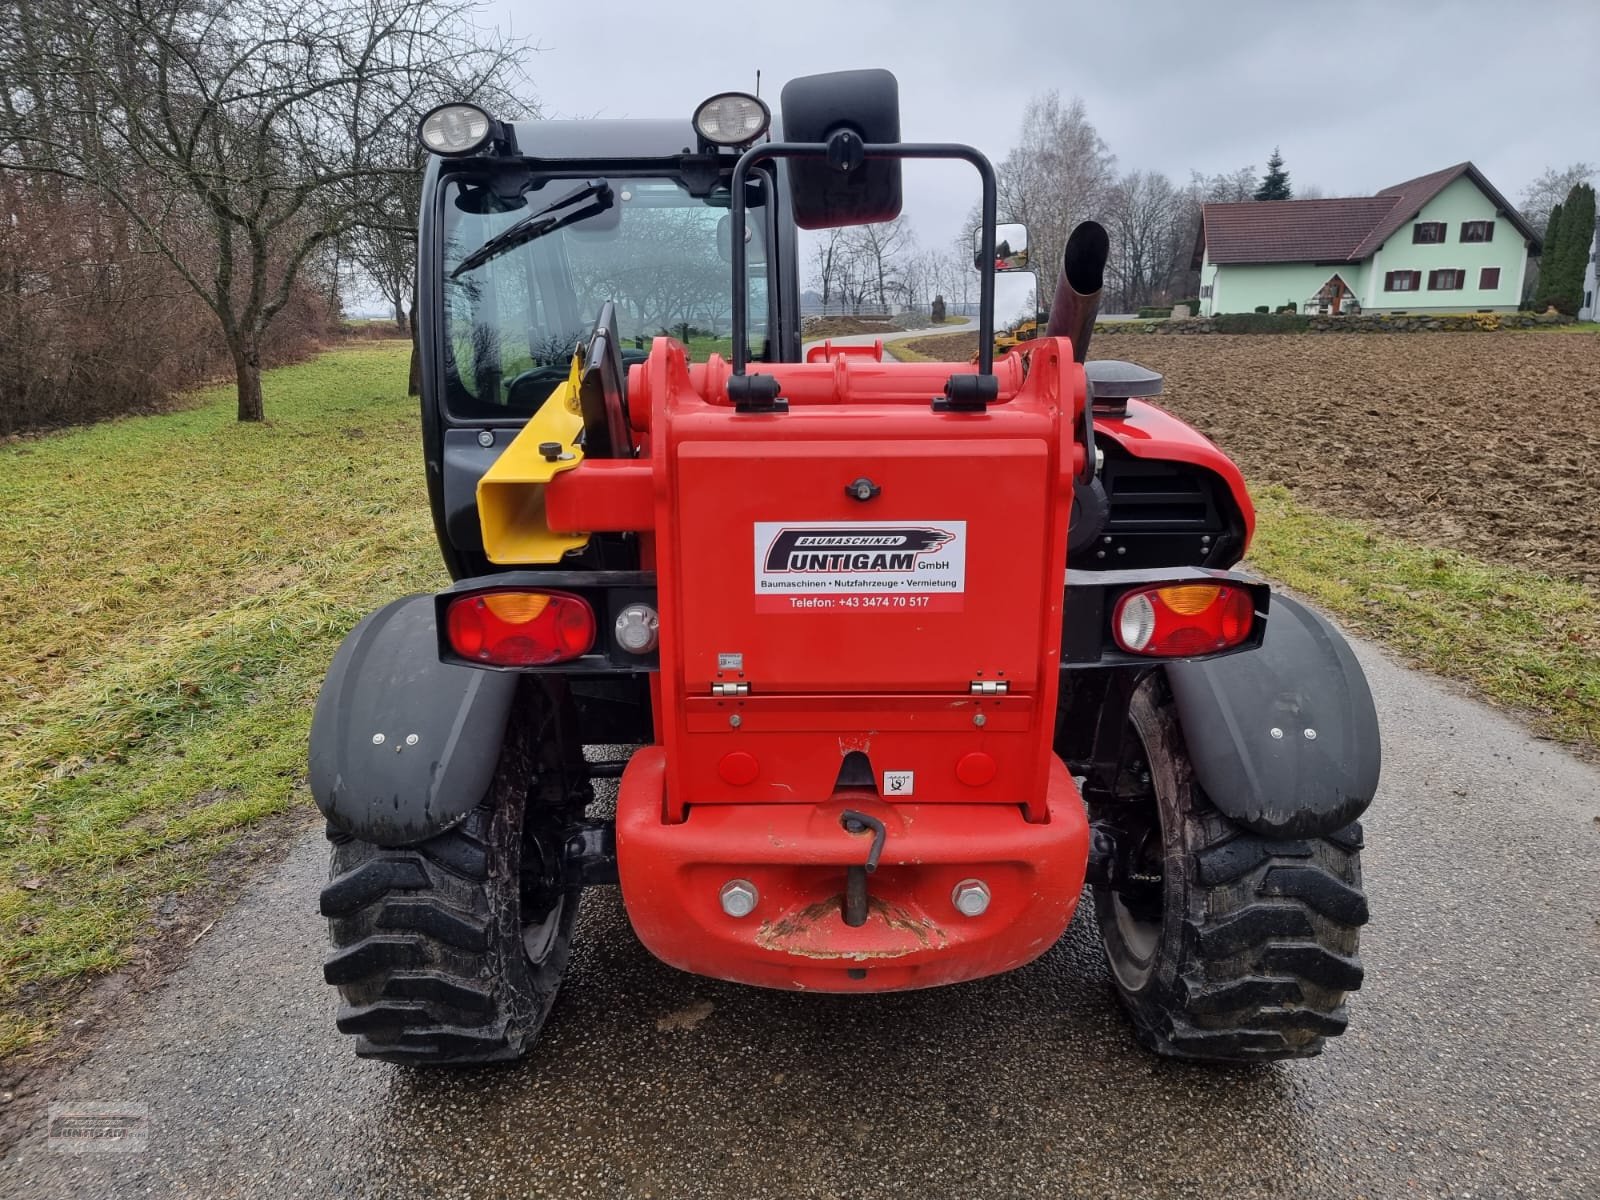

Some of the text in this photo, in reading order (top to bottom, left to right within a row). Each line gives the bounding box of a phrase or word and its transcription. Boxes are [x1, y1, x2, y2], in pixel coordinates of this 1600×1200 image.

[800, 537, 900, 545] BAUMASCHINEN
[918, 561, 949, 570] GmbH
[761, 579, 957, 589] Baumaschinen Nutzfahrzeuge Vermietung
[790, 597, 929, 608] Telefon: +43 3474 70 517
